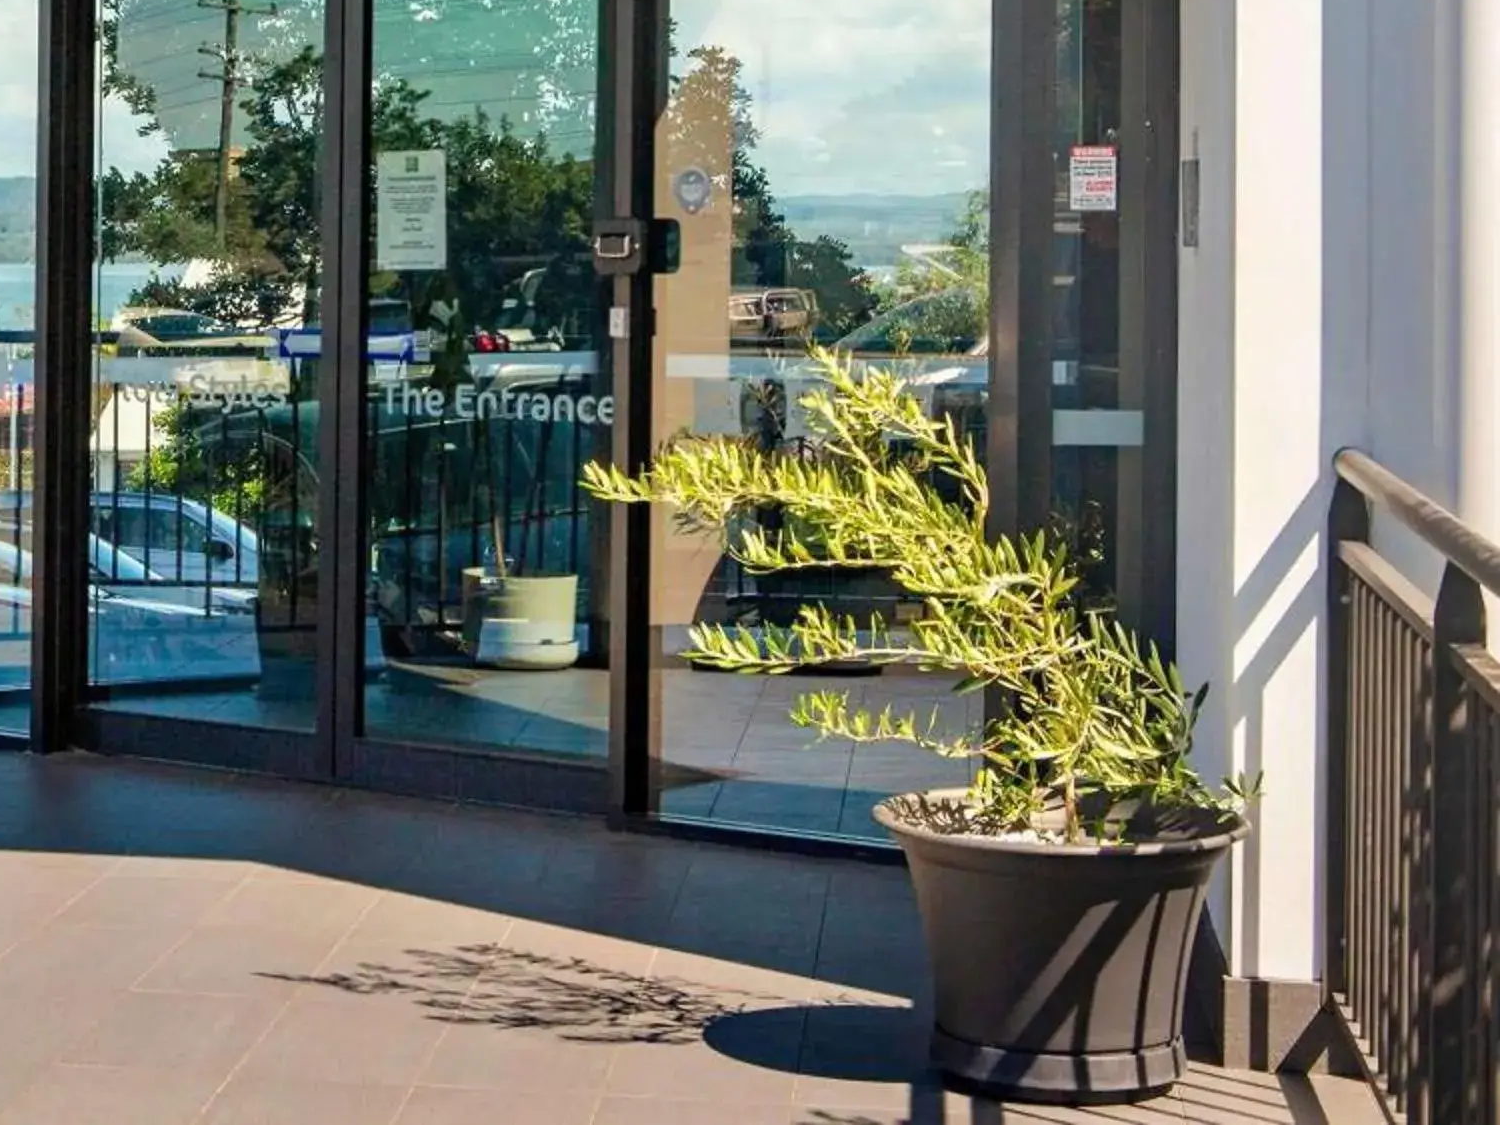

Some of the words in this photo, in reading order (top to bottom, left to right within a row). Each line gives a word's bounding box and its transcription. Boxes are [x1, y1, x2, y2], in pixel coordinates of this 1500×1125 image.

[188, 373, 288, 414] Styles
[382, 381, 445, 417] The
[454, 383, 615, 424] Entrance
